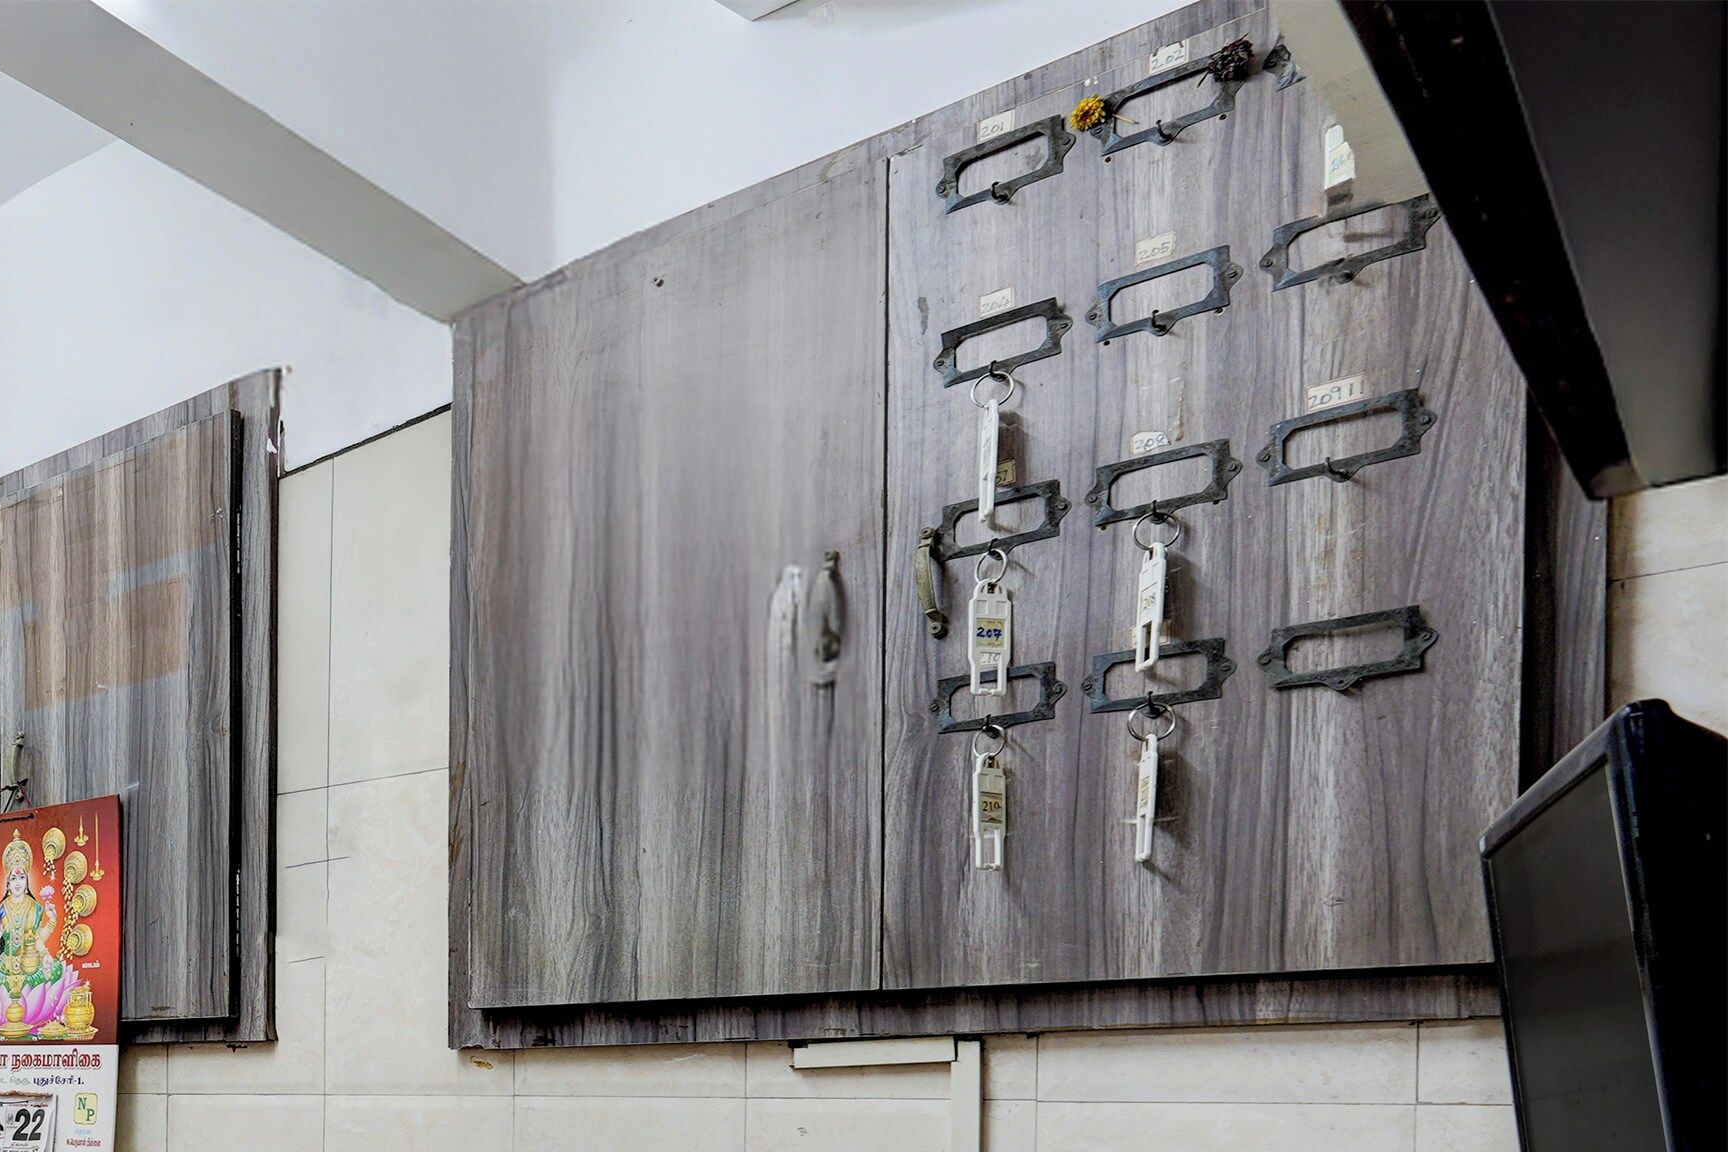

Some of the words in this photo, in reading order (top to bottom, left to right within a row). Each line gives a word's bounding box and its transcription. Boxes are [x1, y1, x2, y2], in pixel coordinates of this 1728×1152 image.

[1151, 49, 1184, 70] 202
[981, 121, 1004, 138] 201
[1138, 241, 1171, 260] 205
[976, 626, 1003, 641] 207
[12, 1108, 46, 1141] 22
